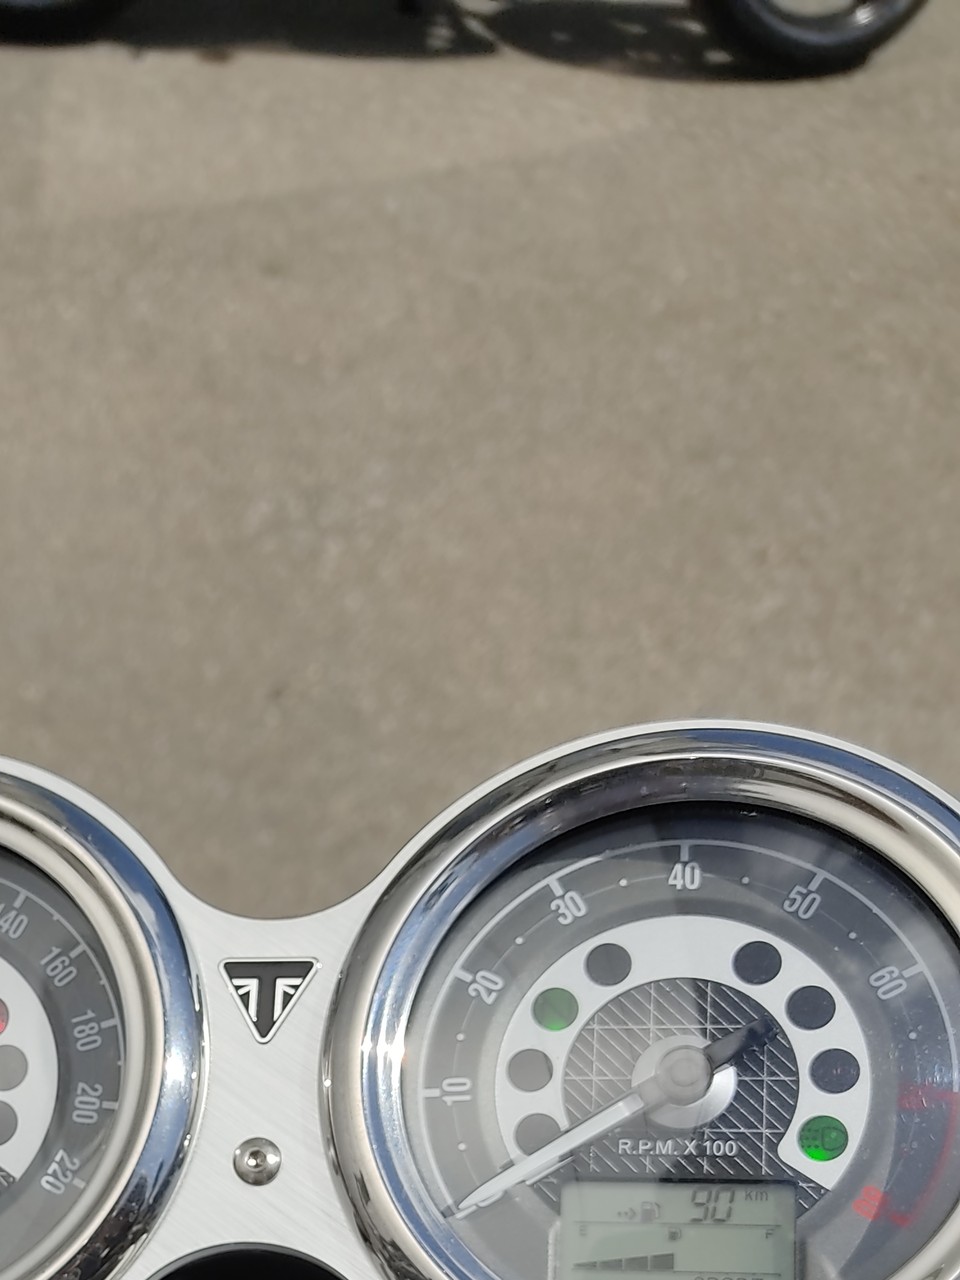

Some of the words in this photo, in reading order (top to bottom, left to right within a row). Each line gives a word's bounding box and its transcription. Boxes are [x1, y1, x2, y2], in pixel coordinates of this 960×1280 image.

[667, 862, 700, 891] 40
[549, 890, 588, 925] 30
[782, 884, 822, 920] 50
[40, 946, 77, 987] 160
[867, 965, 907, 1001] 60
[468, 969, 505, 1006] 20
[71, 1010, 102, 1052] 180
[72, 1082, 103, 1124] 200
[441, 1076, 472, 1105] 10
[618, 1138, 677, 1156] R.P.M.
[682, 1139, 698, 1156] X
[704, 1139, 738, 1157] 100
[41, 1149, 80, 1194] 220
[691, 1186, 735, 1223] 90
[744, 1189, 769, 1202] km
